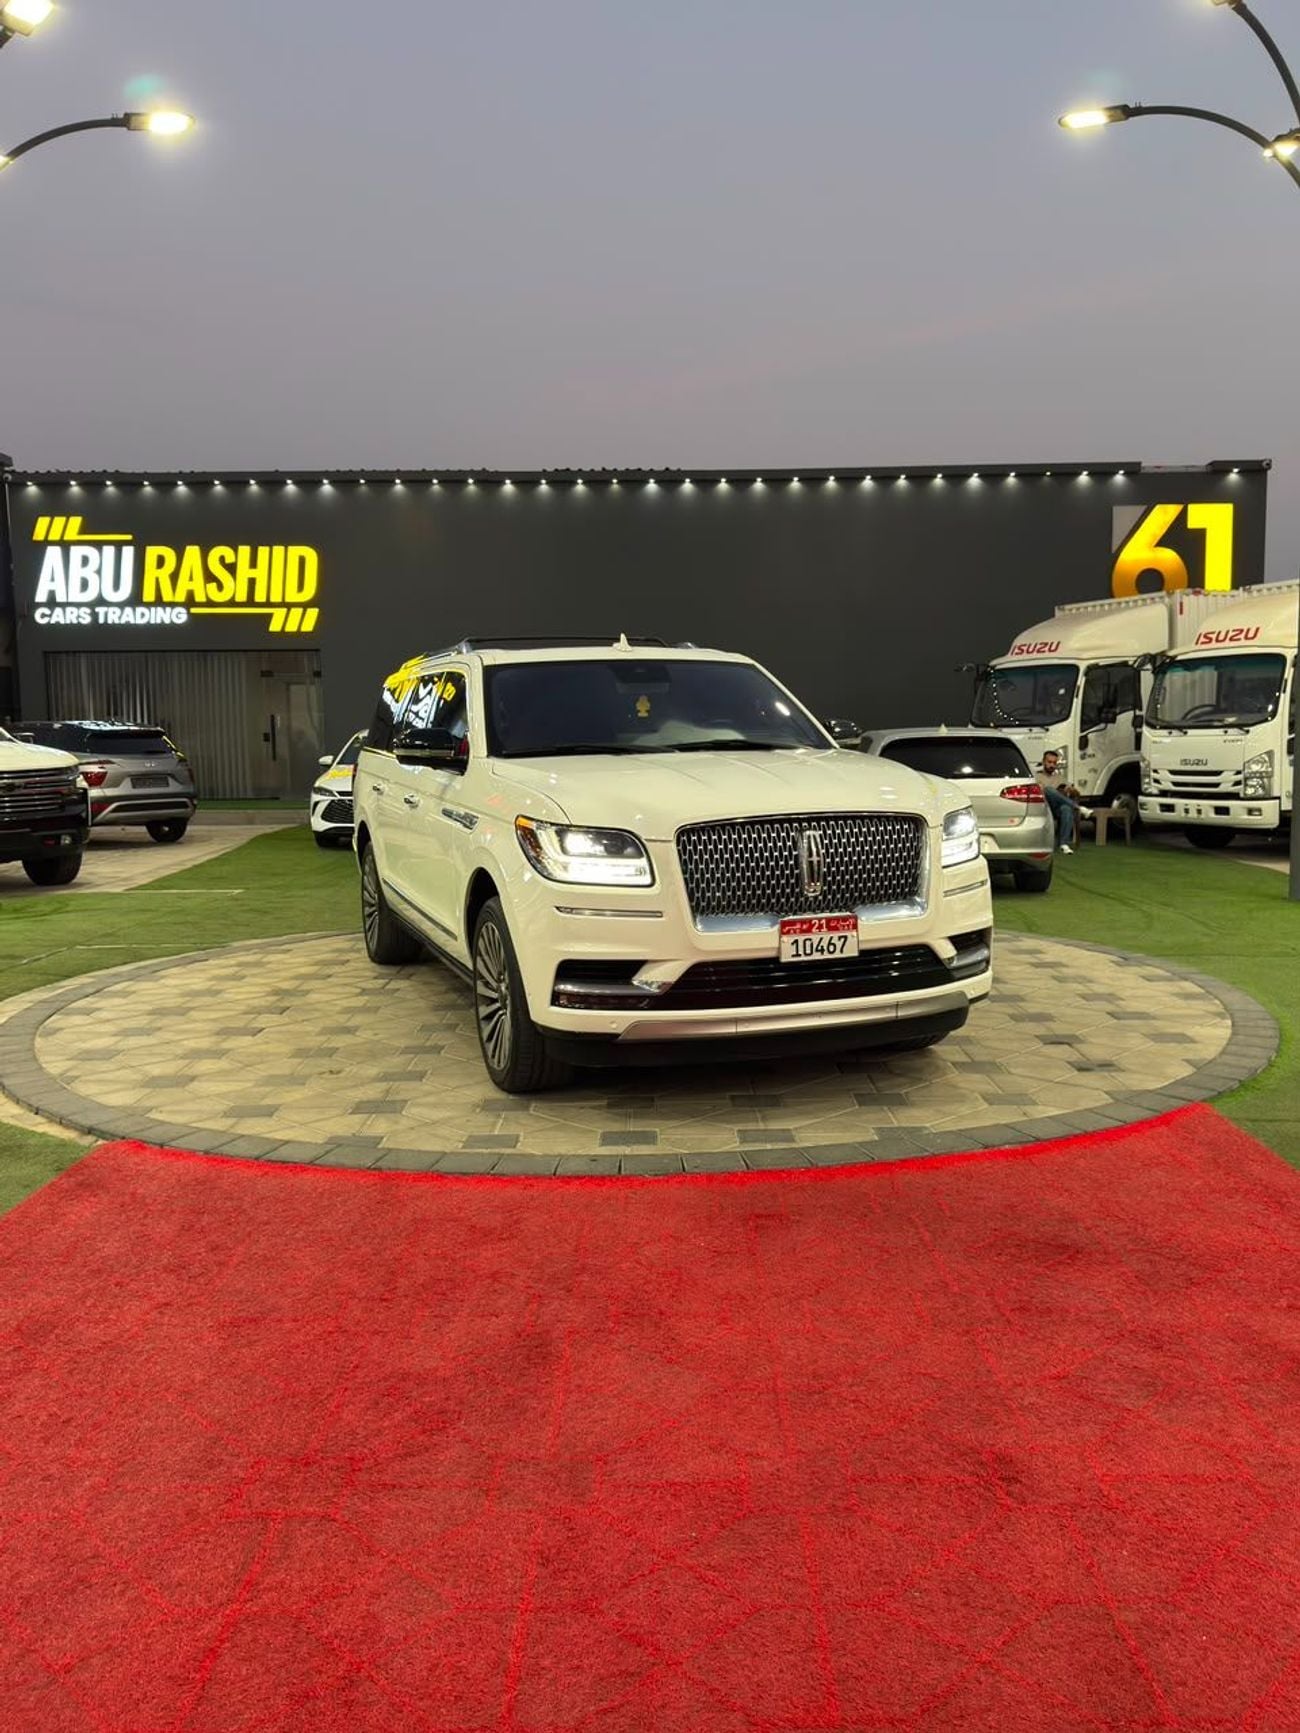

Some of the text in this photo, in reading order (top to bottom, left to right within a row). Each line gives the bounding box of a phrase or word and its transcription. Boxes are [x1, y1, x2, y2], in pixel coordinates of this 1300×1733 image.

[1111, 502, 1235, 599] 61
[34, 545, 319, 603] ABU RASHID
[34, 606, 189, 625] CARS TRADING
[1195, 626, 1261, 646] ISUZU
[1010, 640, 1062, 657] ISUZU
[1180, 758, 1209, 767] ISUZU
[811, 918, 829, 933] 21
[790, 934, 849, 958] 10467
